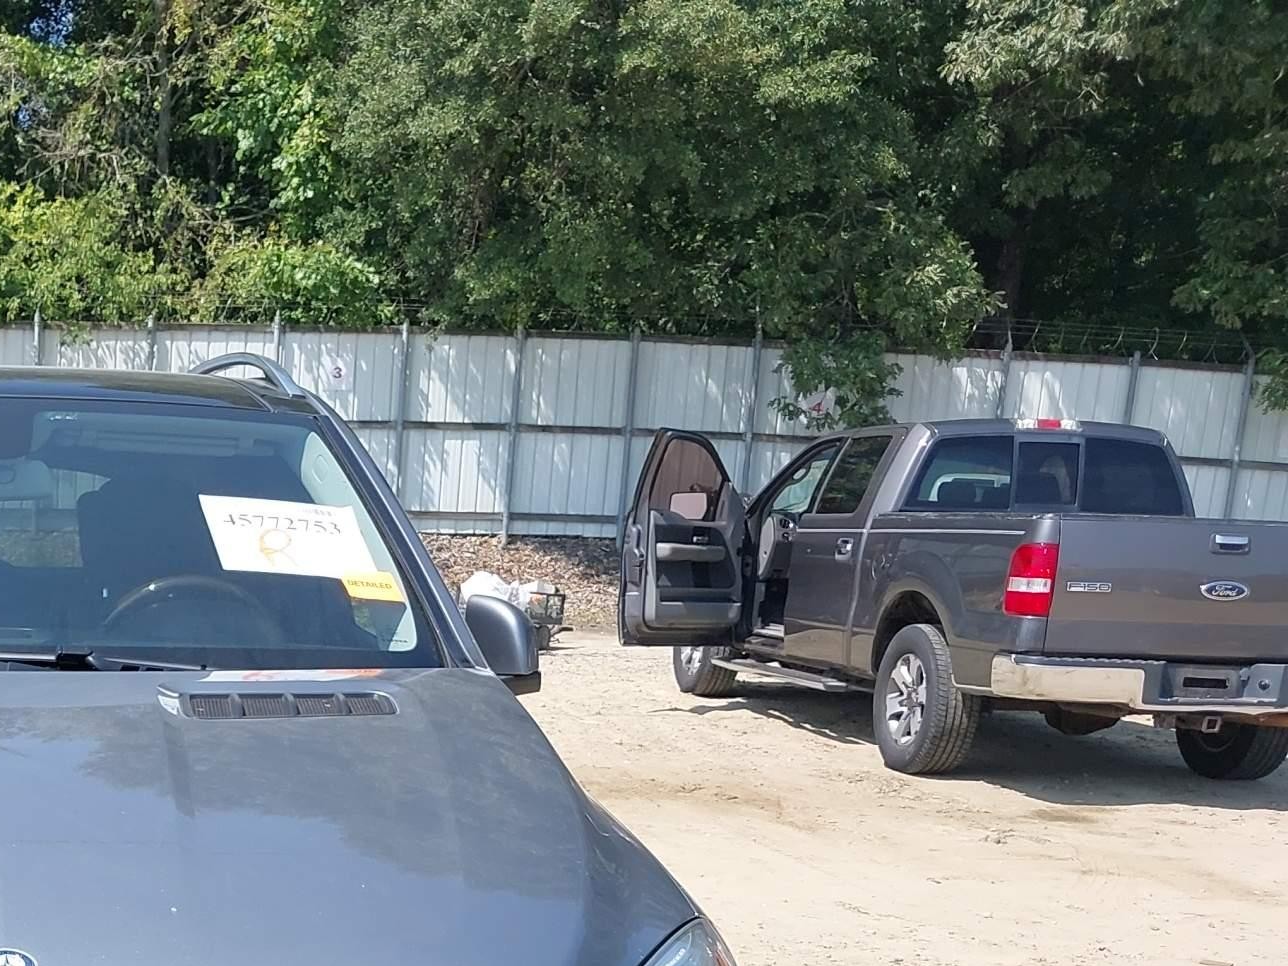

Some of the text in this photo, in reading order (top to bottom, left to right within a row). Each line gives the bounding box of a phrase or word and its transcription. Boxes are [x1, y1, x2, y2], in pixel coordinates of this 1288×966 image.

[332, 367, 343, 379] 3
[223, 514, 341, 535] 45772753
[347, 579, 392, 590] DETAILED
[1212, 585, 1238, 596] Ford
